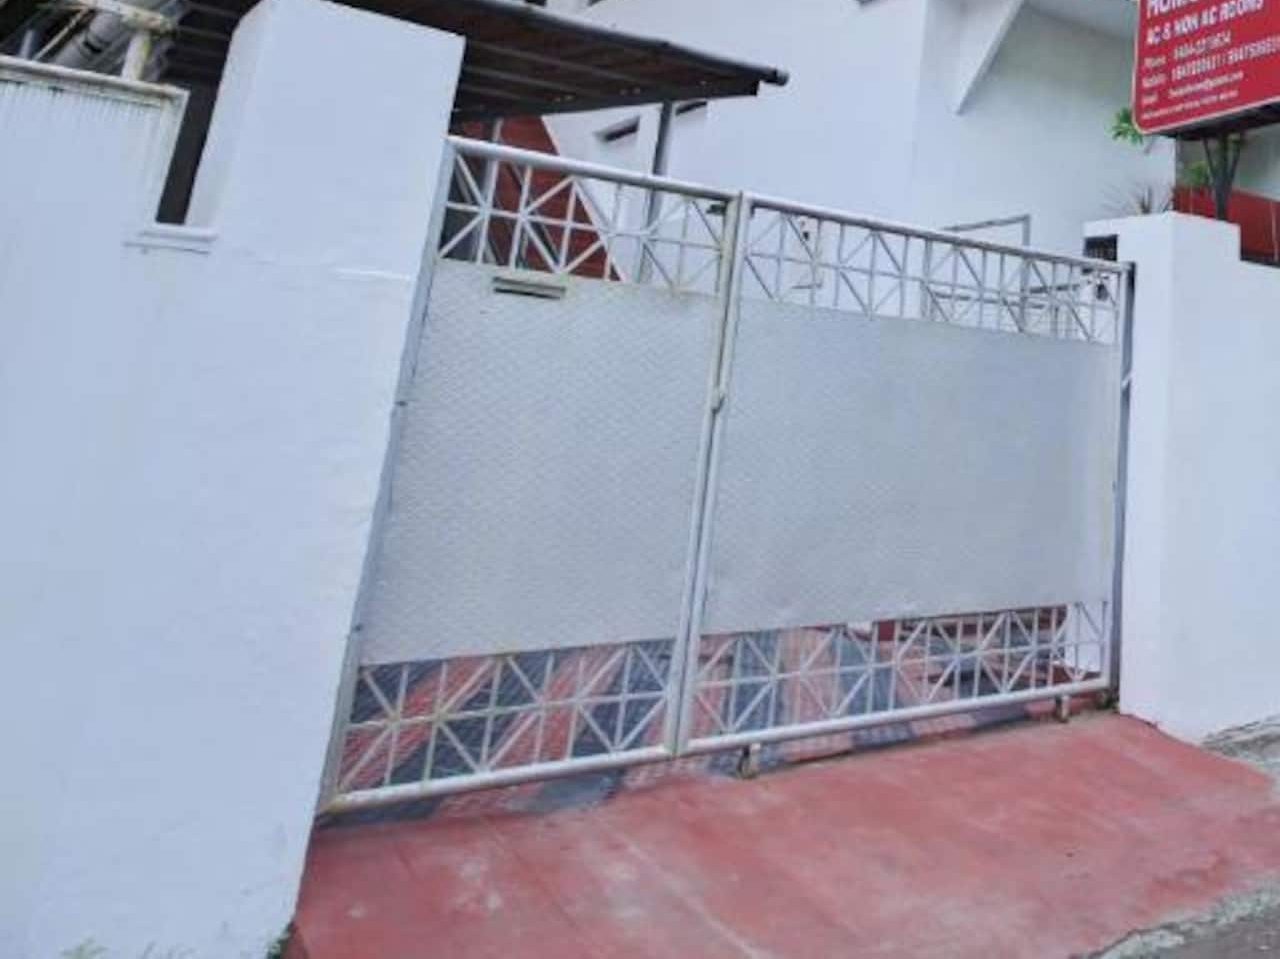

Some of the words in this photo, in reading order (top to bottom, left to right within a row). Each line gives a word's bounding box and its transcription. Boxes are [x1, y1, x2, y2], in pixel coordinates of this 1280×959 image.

[1147, 25, 1161, 45] AC
[1174, 14, 1198, 36] NON
[1201, 5, 1217, 26] AC
